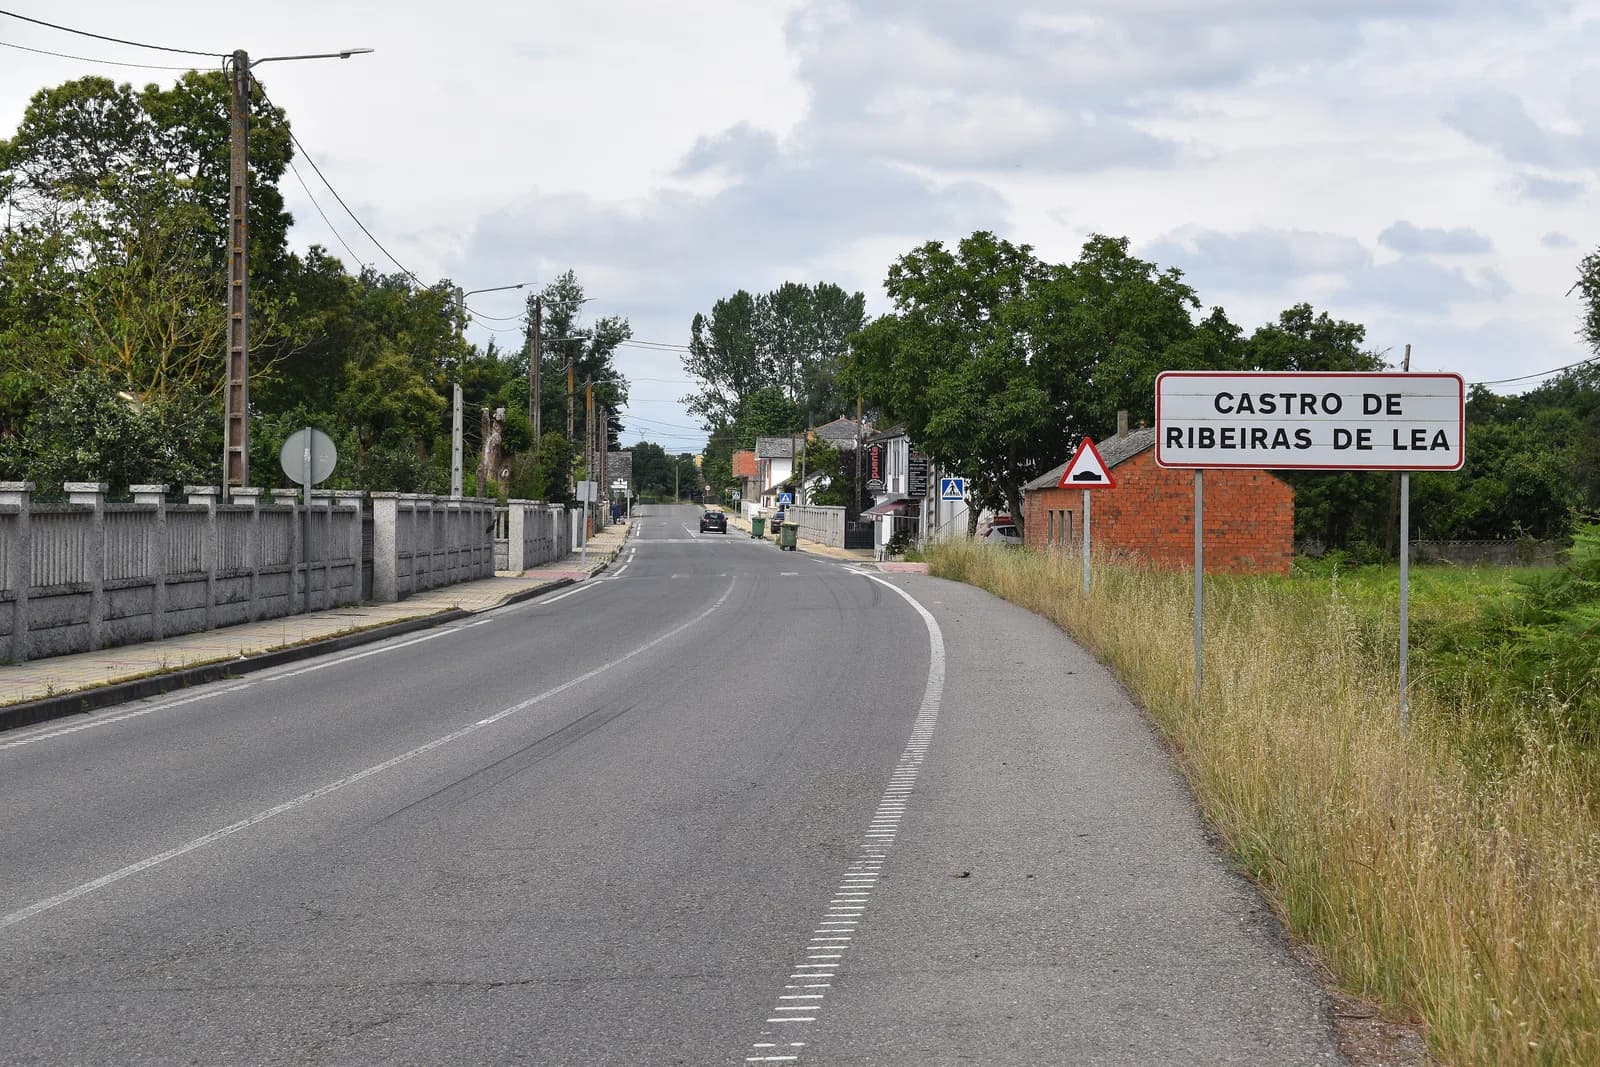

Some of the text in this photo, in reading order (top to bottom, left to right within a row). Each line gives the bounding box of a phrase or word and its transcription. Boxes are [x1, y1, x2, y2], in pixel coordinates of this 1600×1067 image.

[1214, 391, 1403, 416] CASTRO DE
[1166, 426, 1450, 451] RIBEIRAS DE LEA
